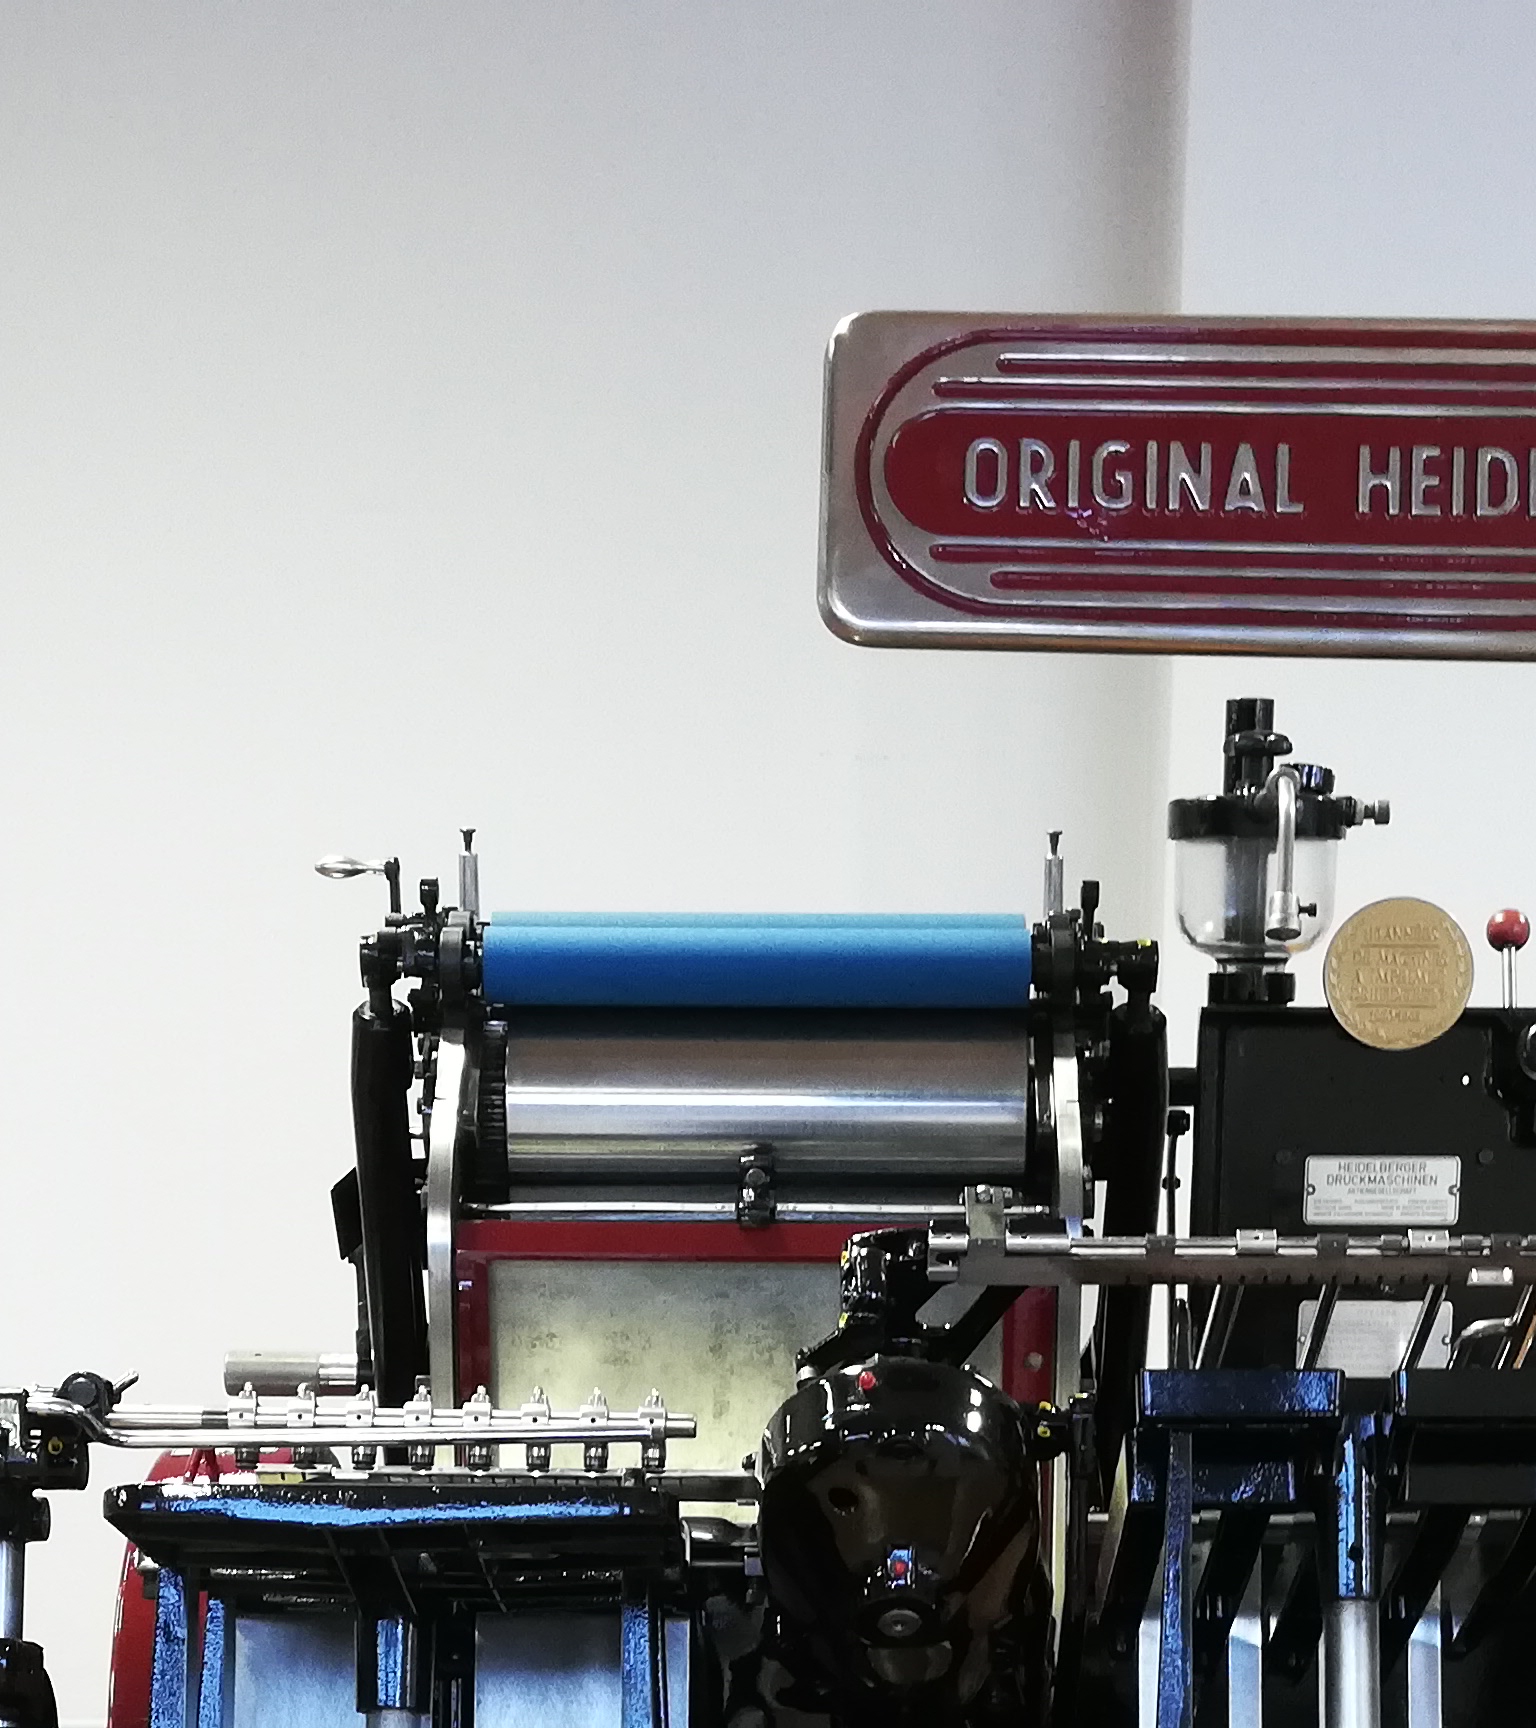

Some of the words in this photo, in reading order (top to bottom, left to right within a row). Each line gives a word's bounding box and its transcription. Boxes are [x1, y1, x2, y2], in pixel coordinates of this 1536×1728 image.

[962, 437, 1305, 517] ORIGINAL
[1337, 1161, 1427, 1174] HEIDELBERGER
[1326, 1174, 1438, 1186] DRUCKMASCHINEN
